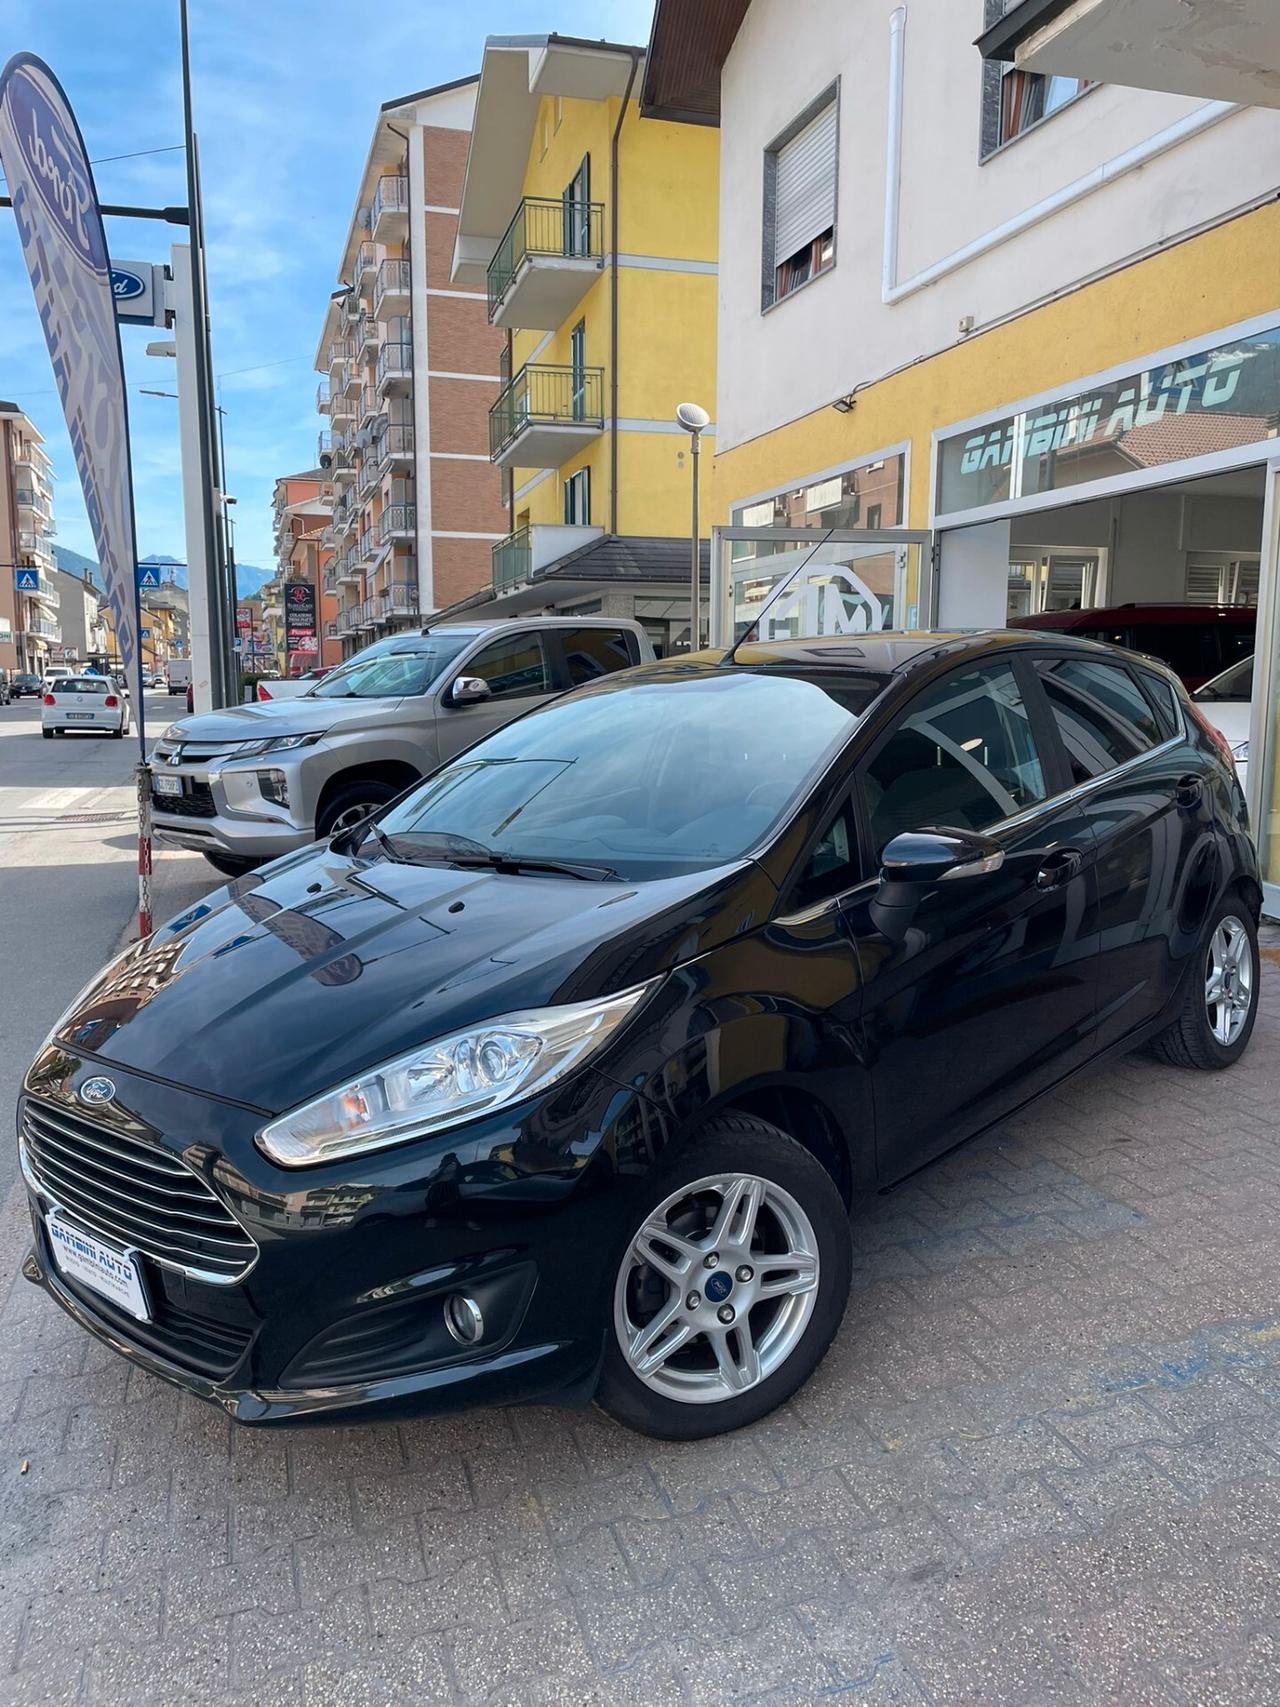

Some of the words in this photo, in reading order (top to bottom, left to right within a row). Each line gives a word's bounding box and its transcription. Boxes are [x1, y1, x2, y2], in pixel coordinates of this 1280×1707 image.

[960, 398, 1103, 475] GAMBINI
[1103, 357, 1245, 437] AUTO
[99, 1250, 132, 1281] AUTO
